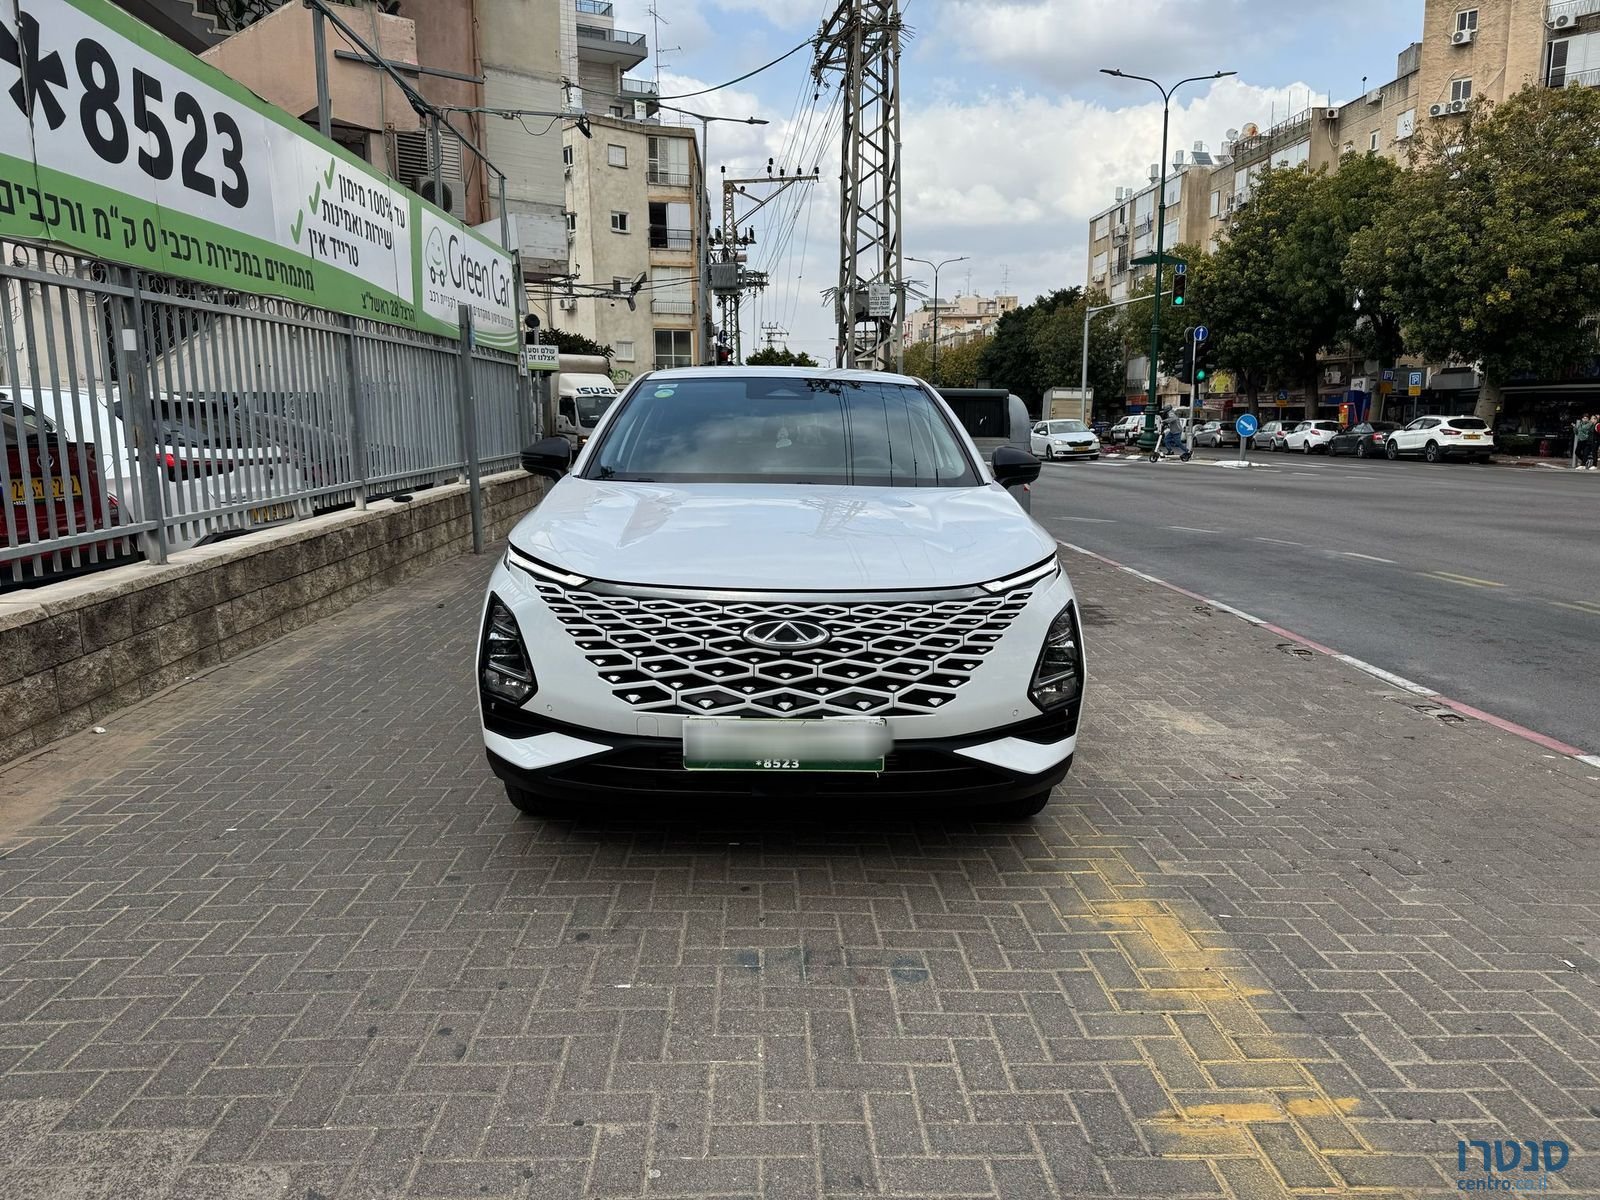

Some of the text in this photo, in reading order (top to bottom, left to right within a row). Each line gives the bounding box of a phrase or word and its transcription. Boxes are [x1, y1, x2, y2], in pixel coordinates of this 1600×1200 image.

[338, 174, 405, 228] עד 100% מימון
[0, 179, 314, 291] מתמחים במכירת רכבי 0 ק"מ ורכבים
[321, 199, 392, 250] שירות ואמינות
[308, 228, 359, 268] טרייד אין
[448, 234, 510, 309] Green Car
[390, 300, 399, 318] 28
[400, 302, 416, 322] הרצל
[429, 290, 439, 304] רכב
[576, 387, 618, 395] ISUZU
